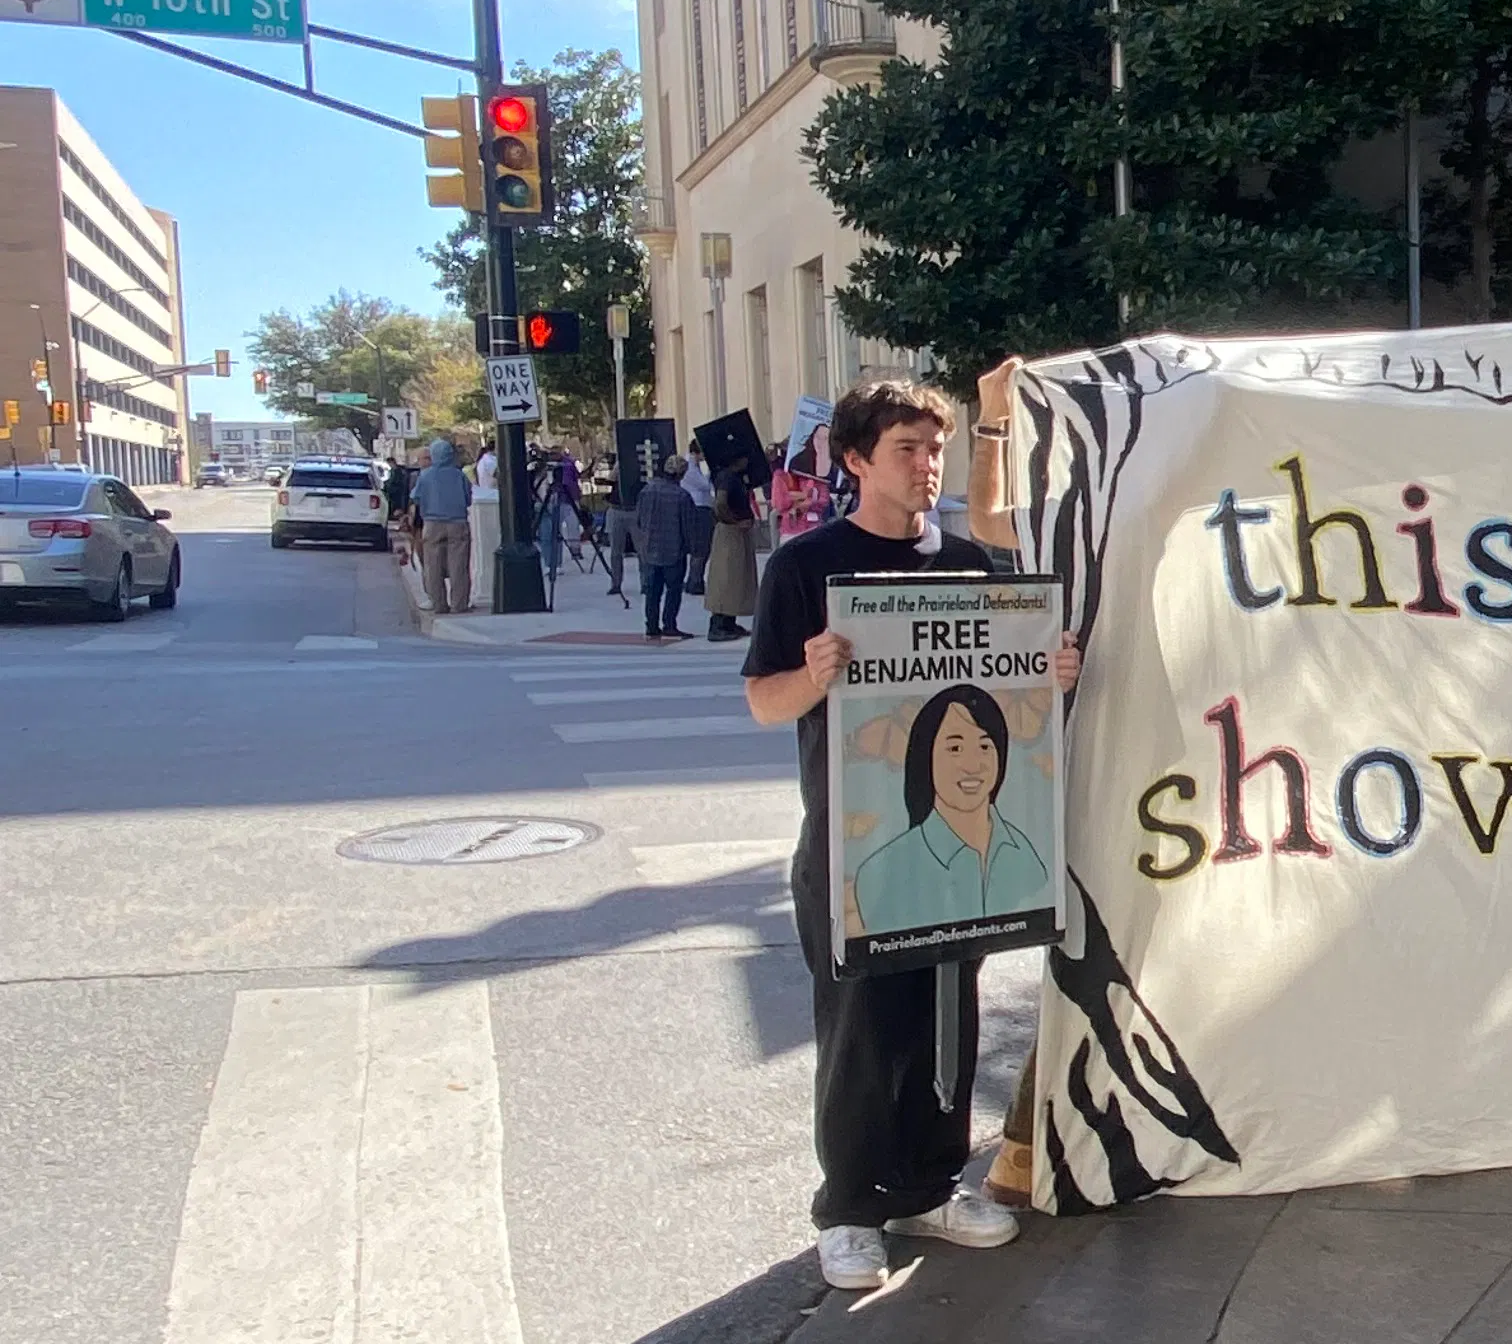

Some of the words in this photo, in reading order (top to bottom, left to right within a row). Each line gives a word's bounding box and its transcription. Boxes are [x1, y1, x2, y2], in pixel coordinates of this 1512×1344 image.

[111, 11, 146, 27] 400
[252, 23, 287, 38] 500
[492, 363, 530, 380] ONE
[495, 378, 531, 398] WAY
[850, 596, 877, 614] Free
[879, 595, 896, 613] all
[897, 594, 915, 612] the
[917, 593, 981, 612] Prairieland
[983, 591, 1048, 611] Defendants!
[912, 619, 990, 651] FREE
[848, 654, 973, 685] BENJAMIN
[980, 651, 1049, 678] SONG
[869, 920, 1027, 955] PrairielandDefendants.com
